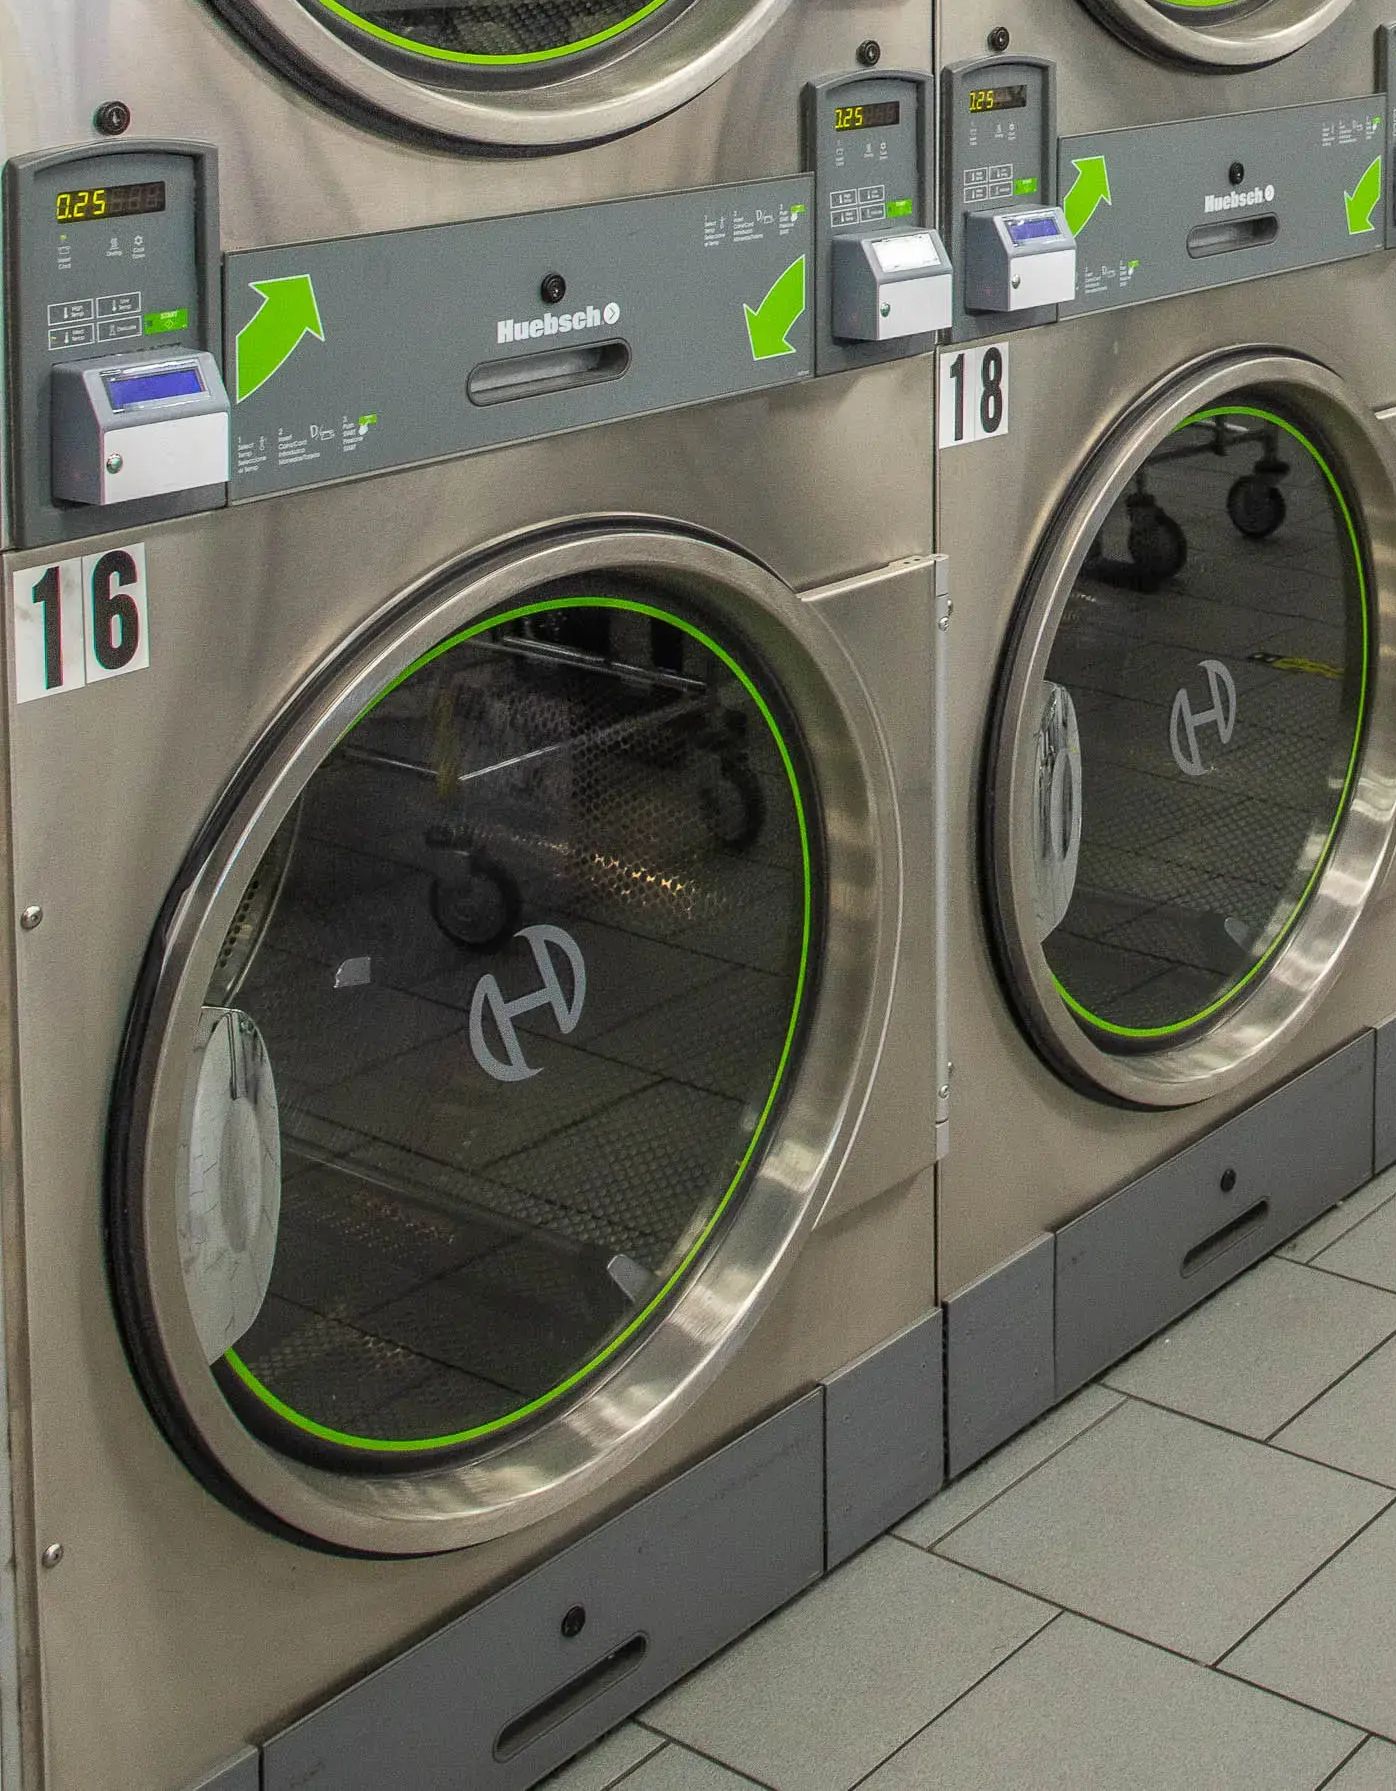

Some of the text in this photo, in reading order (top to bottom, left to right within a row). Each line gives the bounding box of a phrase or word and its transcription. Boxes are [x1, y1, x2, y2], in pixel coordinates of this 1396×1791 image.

[56, 189, 106, 220] 0.25
[1204, 186, 1264, 213] Huebsch
[497, 305, 601, 344] Huebsch
[950, 347, 1002, 441] 18
[32, 550, 140, 690] 16
